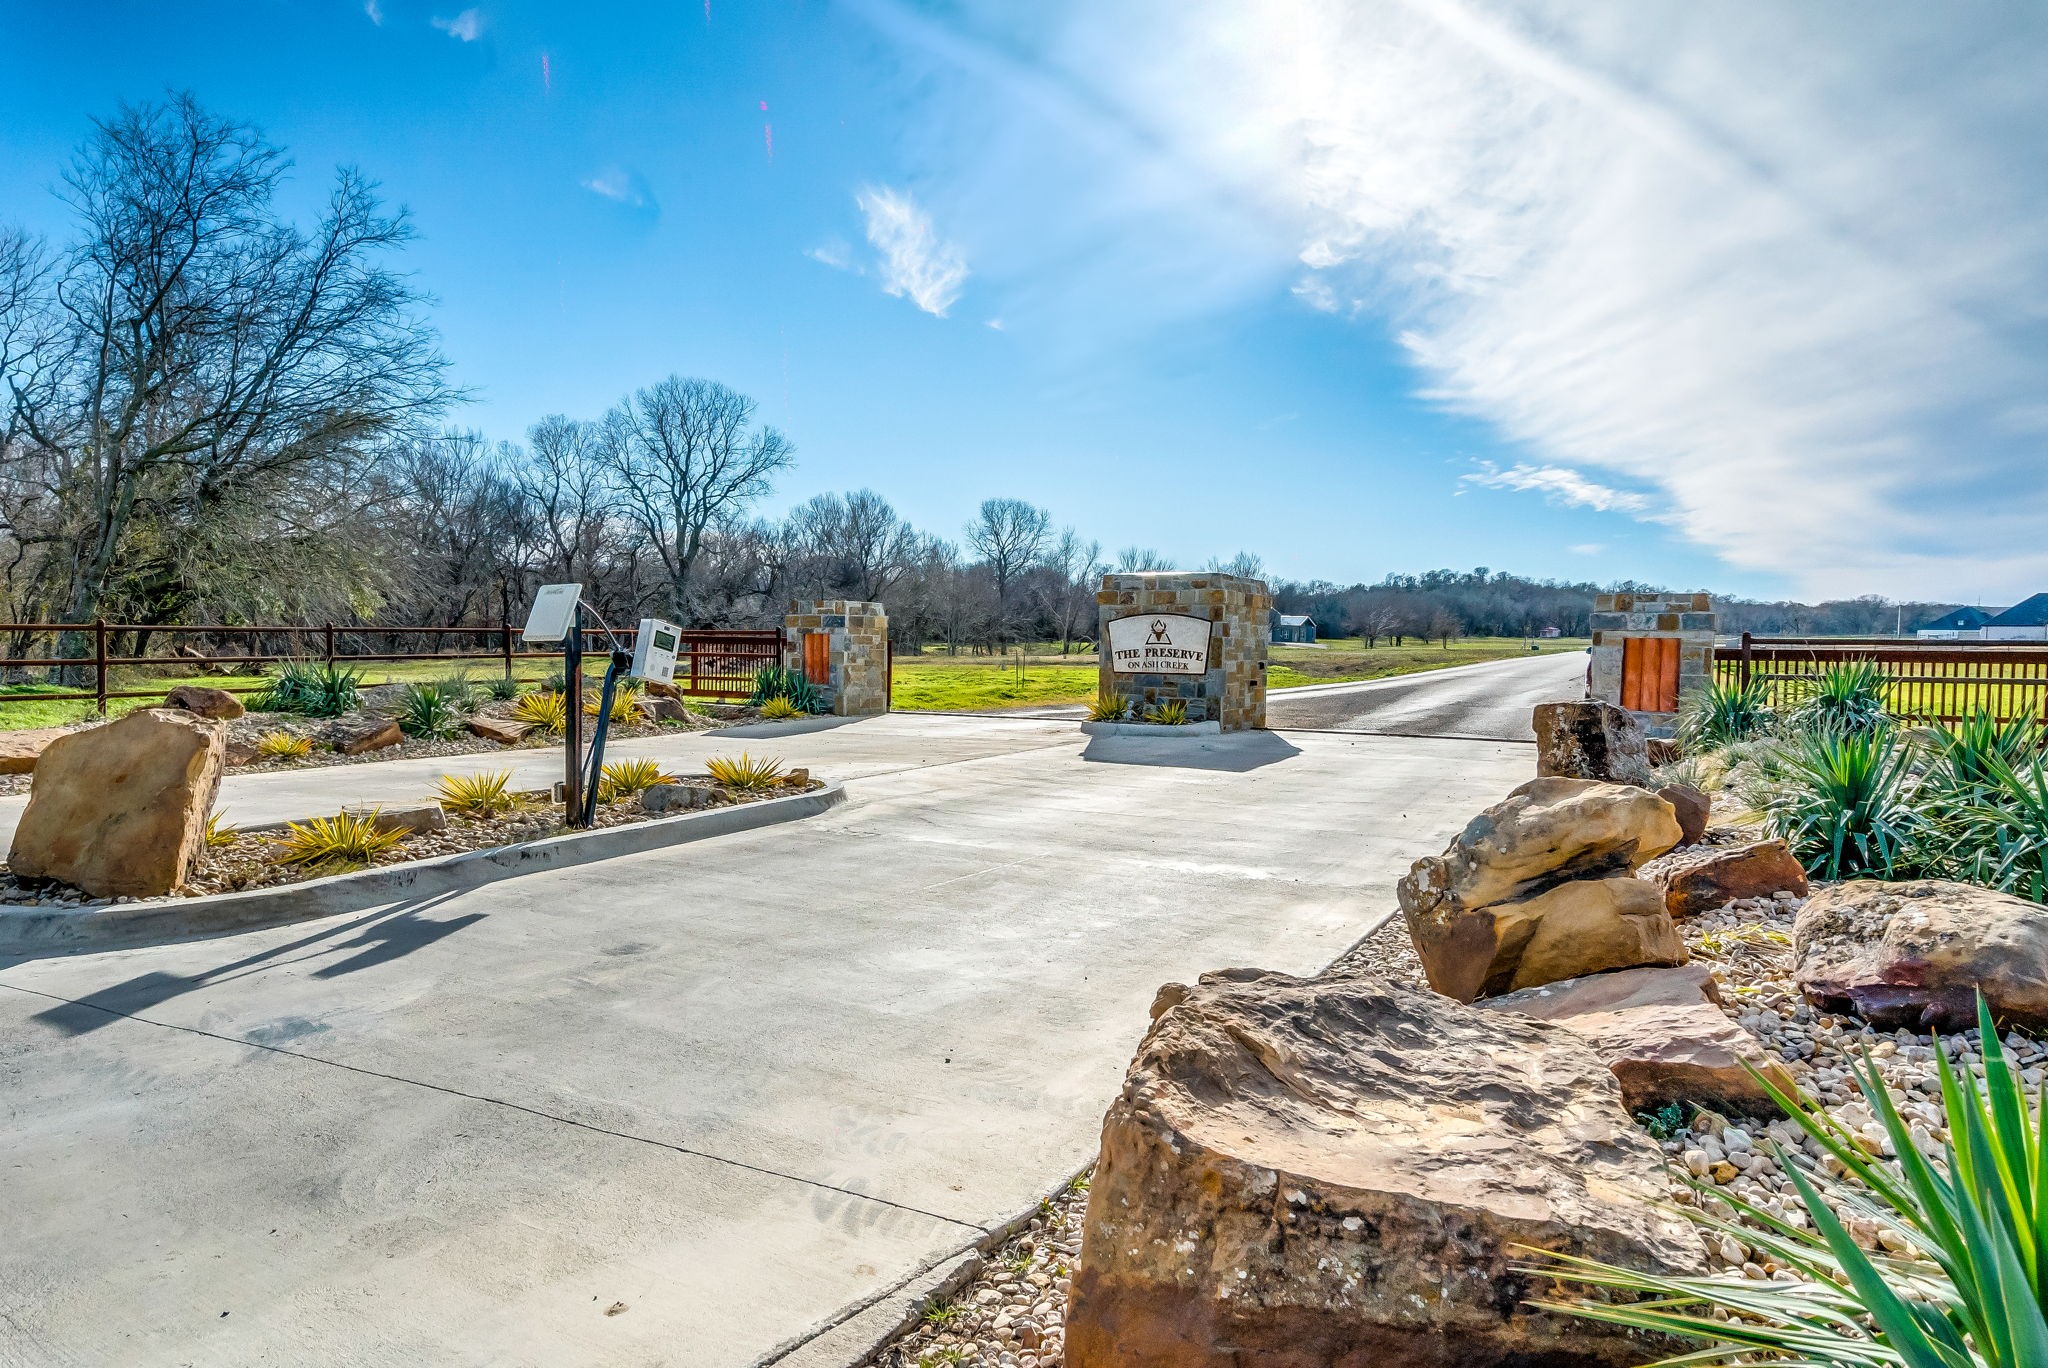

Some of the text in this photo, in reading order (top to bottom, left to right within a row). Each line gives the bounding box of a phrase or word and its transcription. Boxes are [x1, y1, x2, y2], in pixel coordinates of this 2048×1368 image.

[1115, 648, 1203, 661] THE PRESERVE
[1128, 661, 1189, 670] ON ASH CREEK
